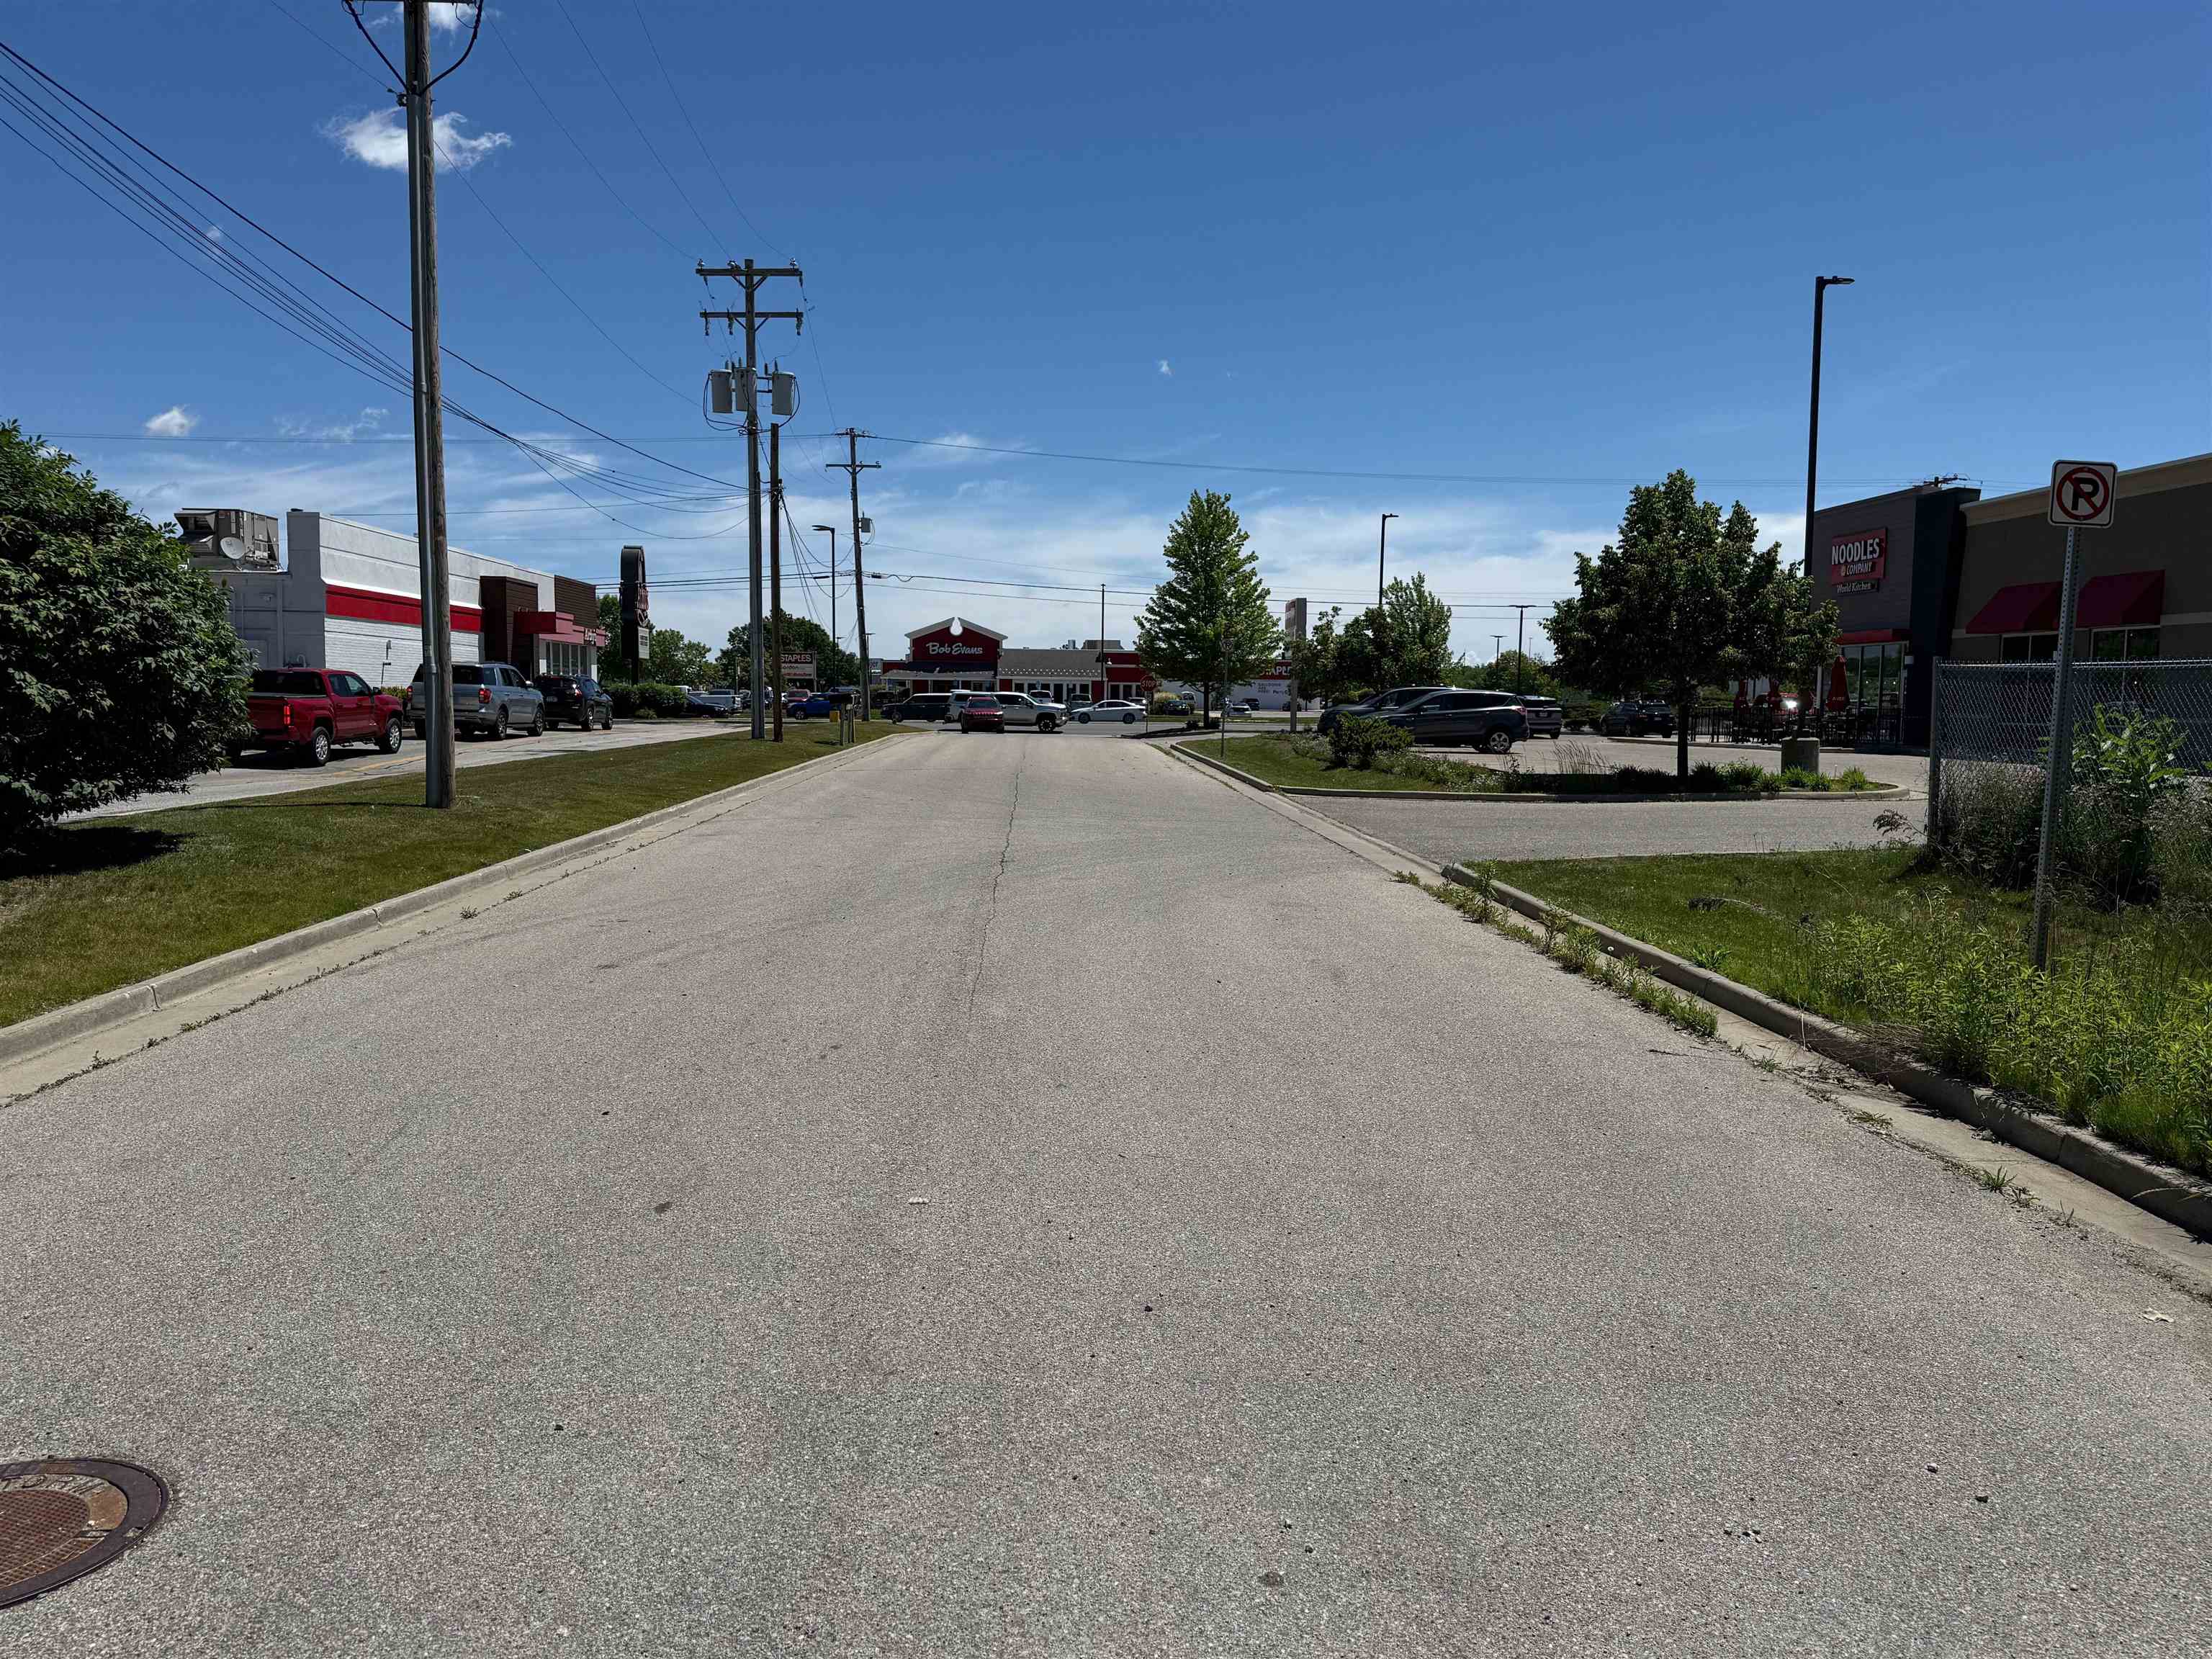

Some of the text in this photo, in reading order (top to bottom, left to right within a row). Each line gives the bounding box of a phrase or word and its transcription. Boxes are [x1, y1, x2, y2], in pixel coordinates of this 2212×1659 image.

[1831, 537, 1880, 565] NOODLES
[1846, 561, 1872, 575] COMPANY
[1837, 581, 1871, 593] World Kitchen
[926, 642, 984, 655] Bob Evans
